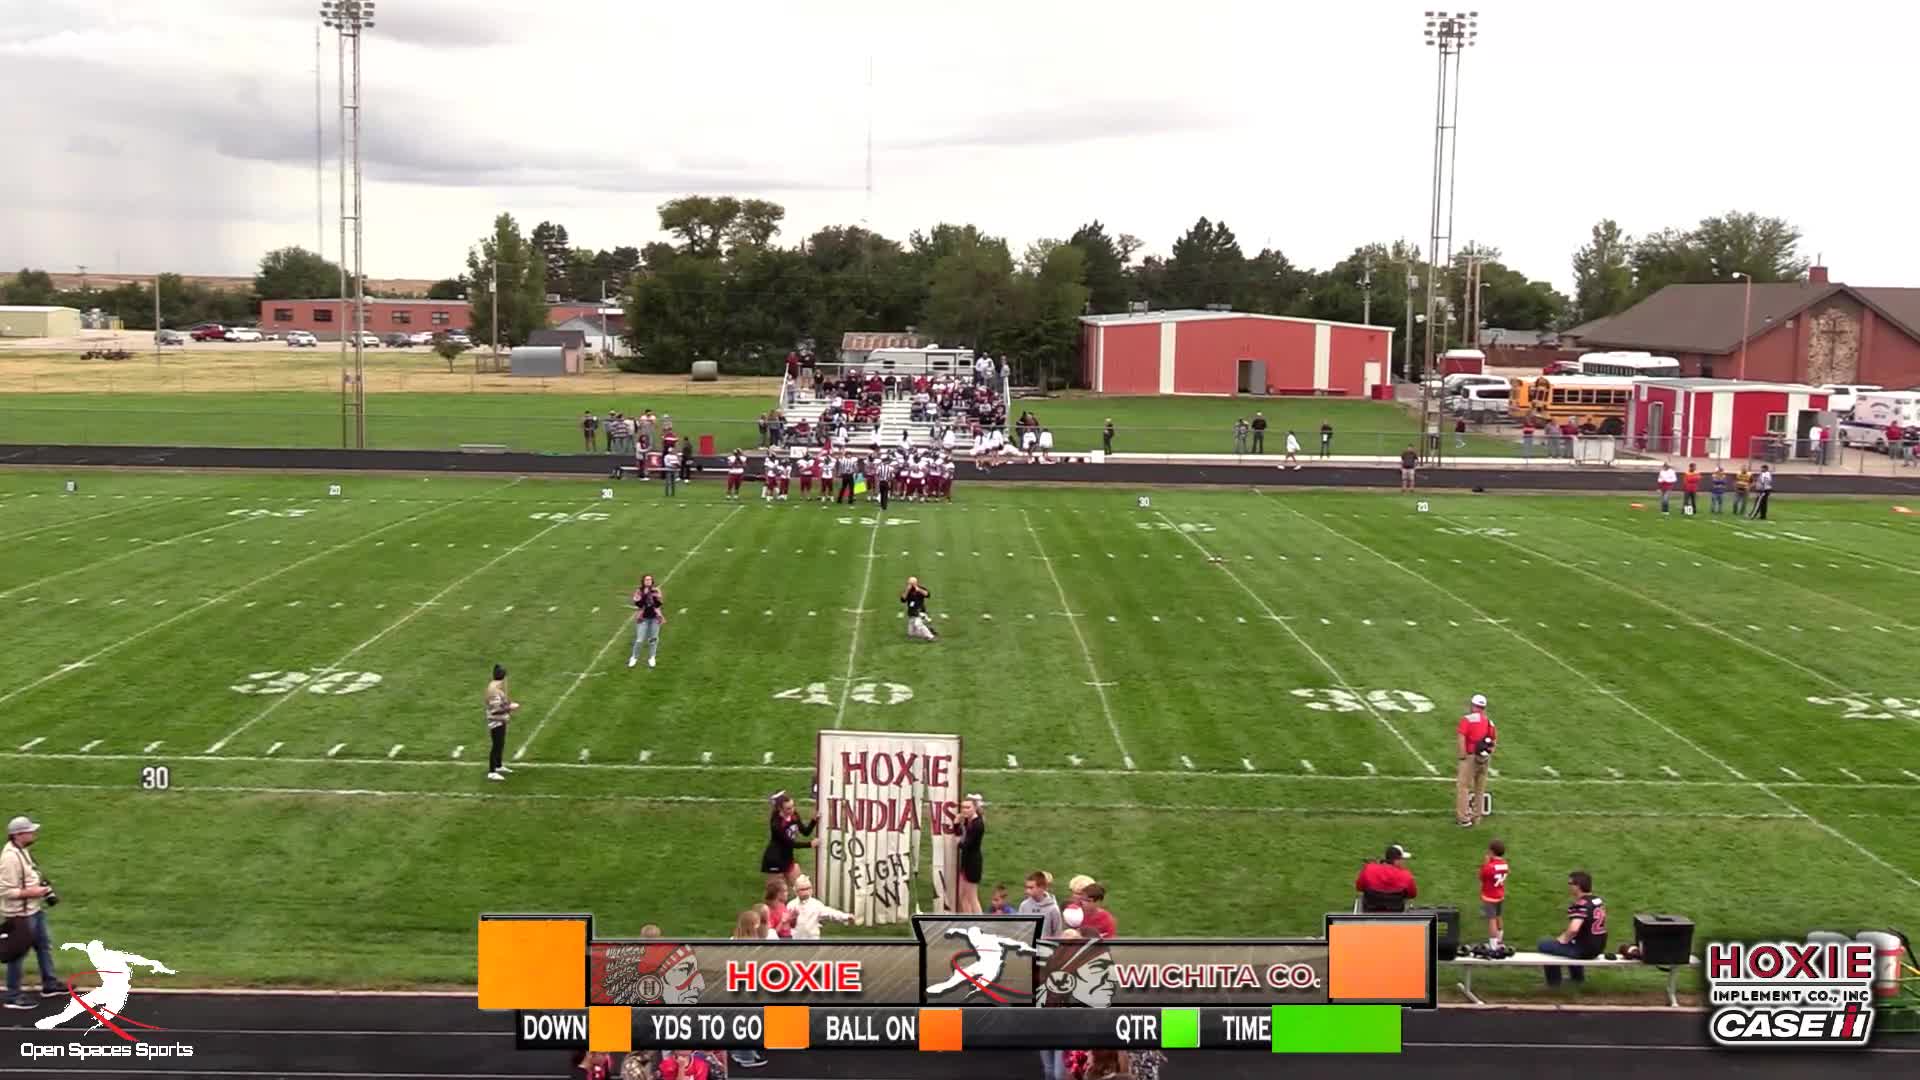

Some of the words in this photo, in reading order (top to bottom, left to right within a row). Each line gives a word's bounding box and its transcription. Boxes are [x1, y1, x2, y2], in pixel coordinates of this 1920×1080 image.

[772, 682, 914, 706] 40
[1288, 688, 1436, 713] 30
[142, 766, 169, 790] 30
[840, 750, 952, 788] HOXIE
[830, 836, 865, 863] GO
